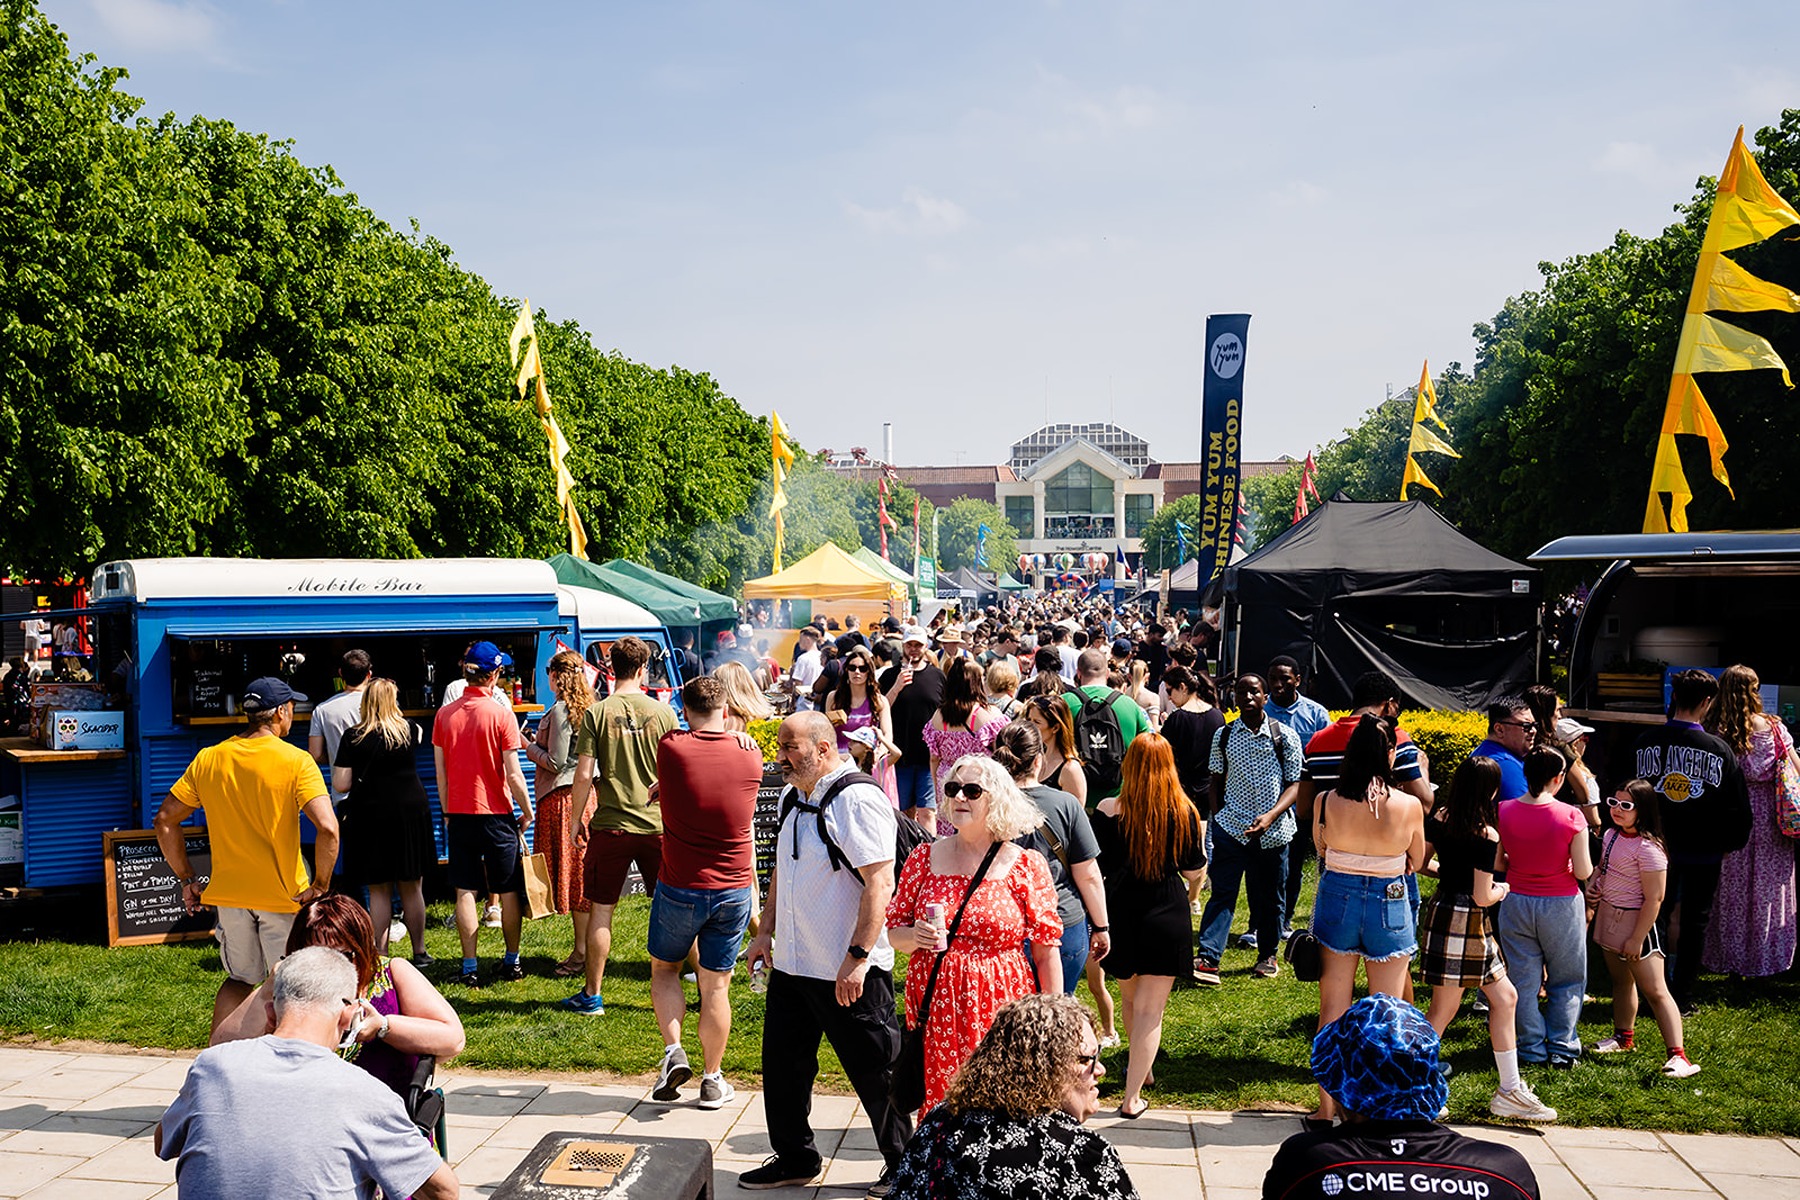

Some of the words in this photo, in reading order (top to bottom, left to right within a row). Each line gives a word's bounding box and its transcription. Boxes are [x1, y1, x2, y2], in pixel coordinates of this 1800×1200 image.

[1214, 341, 1238, 367] yum
[1217, 352, 1240, 373] yum
[1207, 431, 1223, 488] YUM
[1210, 474, 1236, 580] CHINESE
[1225, 399, 1240, 469] FOOD
[1201, 493, 1219, 550] YUM
[288, 577, 370, 592] Mobile
[374, 576, 427, 591] Bar
[1636, 745, 1661, 779] LOS
[1664, 744, 1724, 788] ANGELES
[1654, 775, 1705, 798] LAKERS
[118, 845, 159, 857] PROSECCO
[1347, 1172, 1406, 1192] CME
[1409, 1173, 1490, 1200] Group
